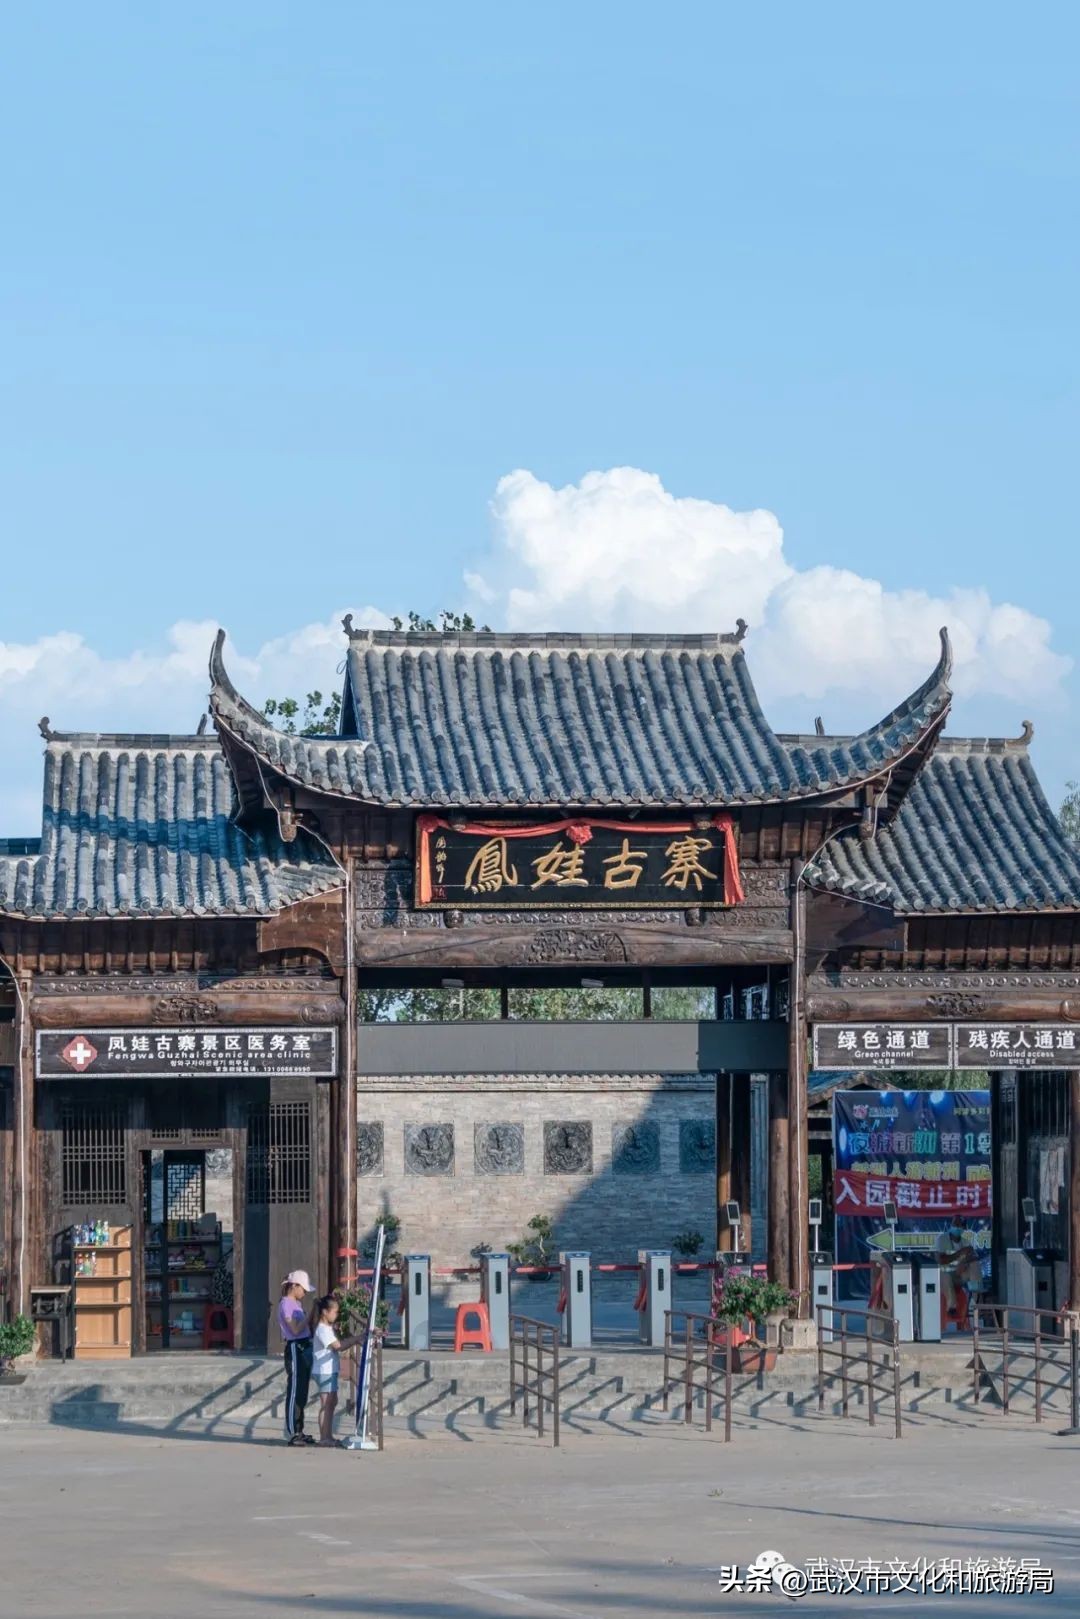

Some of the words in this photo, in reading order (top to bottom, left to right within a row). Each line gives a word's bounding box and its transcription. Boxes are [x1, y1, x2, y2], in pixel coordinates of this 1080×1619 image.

[464, 835, 718, 895] 鳳娃古寨
[108, 1034, 311, 1052] 凤娃古寨景区医务室
[838, 1030, 931, 1050] 绿色通道
[968, 1029, 1076, 1050] 残疾人通道
[108, 1052, 154, 1061] Fengwa
[203, 1051, 243, 1059] Scenic
[247, 1051, 273, 1059] area
[277, 1051, 311, 1059] clinic
[854, 1050, 880, 1058] Green
[881, 1050, 914, 1058] channel
[989, 1050, 1026, 1058] Disabled
[836, 1177, 992, 1208] 入园截止时
